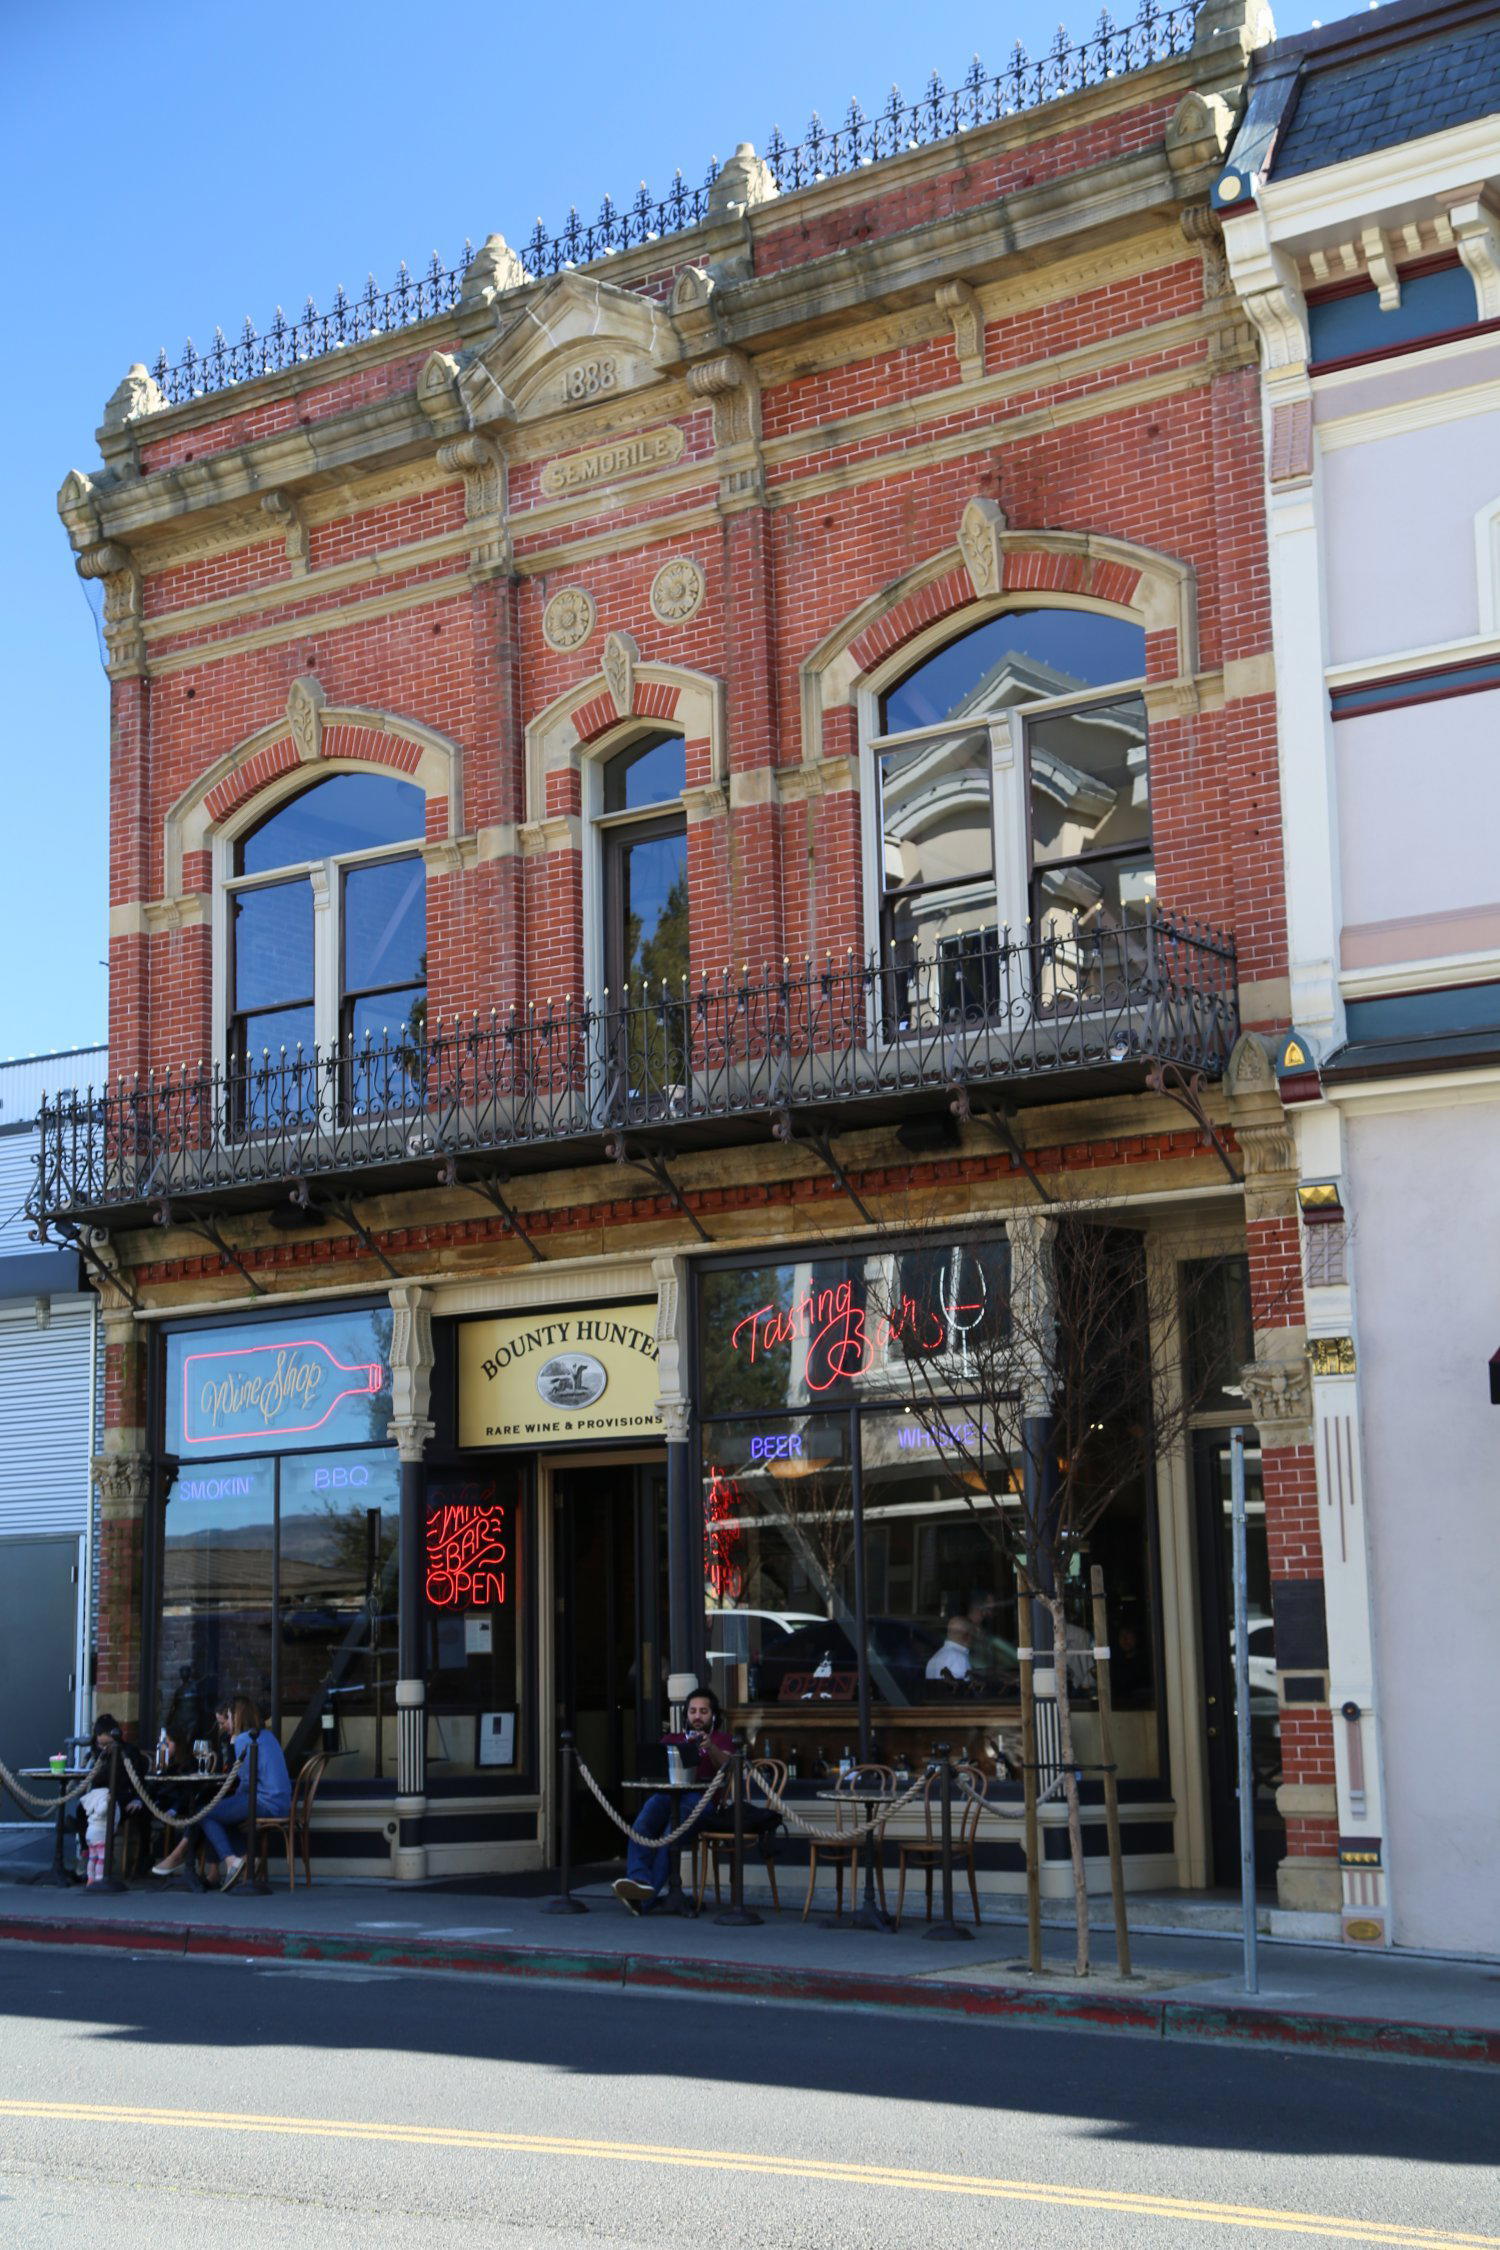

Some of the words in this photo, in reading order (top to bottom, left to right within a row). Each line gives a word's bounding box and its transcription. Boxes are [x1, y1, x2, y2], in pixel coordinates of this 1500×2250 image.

[561, 355, 617, 401] 1888
[732, 1278, 852, 1363] Tasting
[806, 1292, 943, 1390] Bar
[480, 1321, 570, 1381] BOUNTY
[201, 1374, 262, 1427] Wine
[260, 1349, 322, 1424] Shop
[486, 1424, 520, 1436] RARE
[525, 1421, 559, 1433] WINE
[565, 1421, 573, 1430] &
[578, 1415, 663, 1430] PROVISIONS
[750, 1433, 803, 1459] BEER
[314, 1465, 369, 1489] BBQ
[446, 1518, 495, 1573] BAR
[426, 1570, 504, 1605] OPEN
[785, 1676, 852, 1696] OPEN
